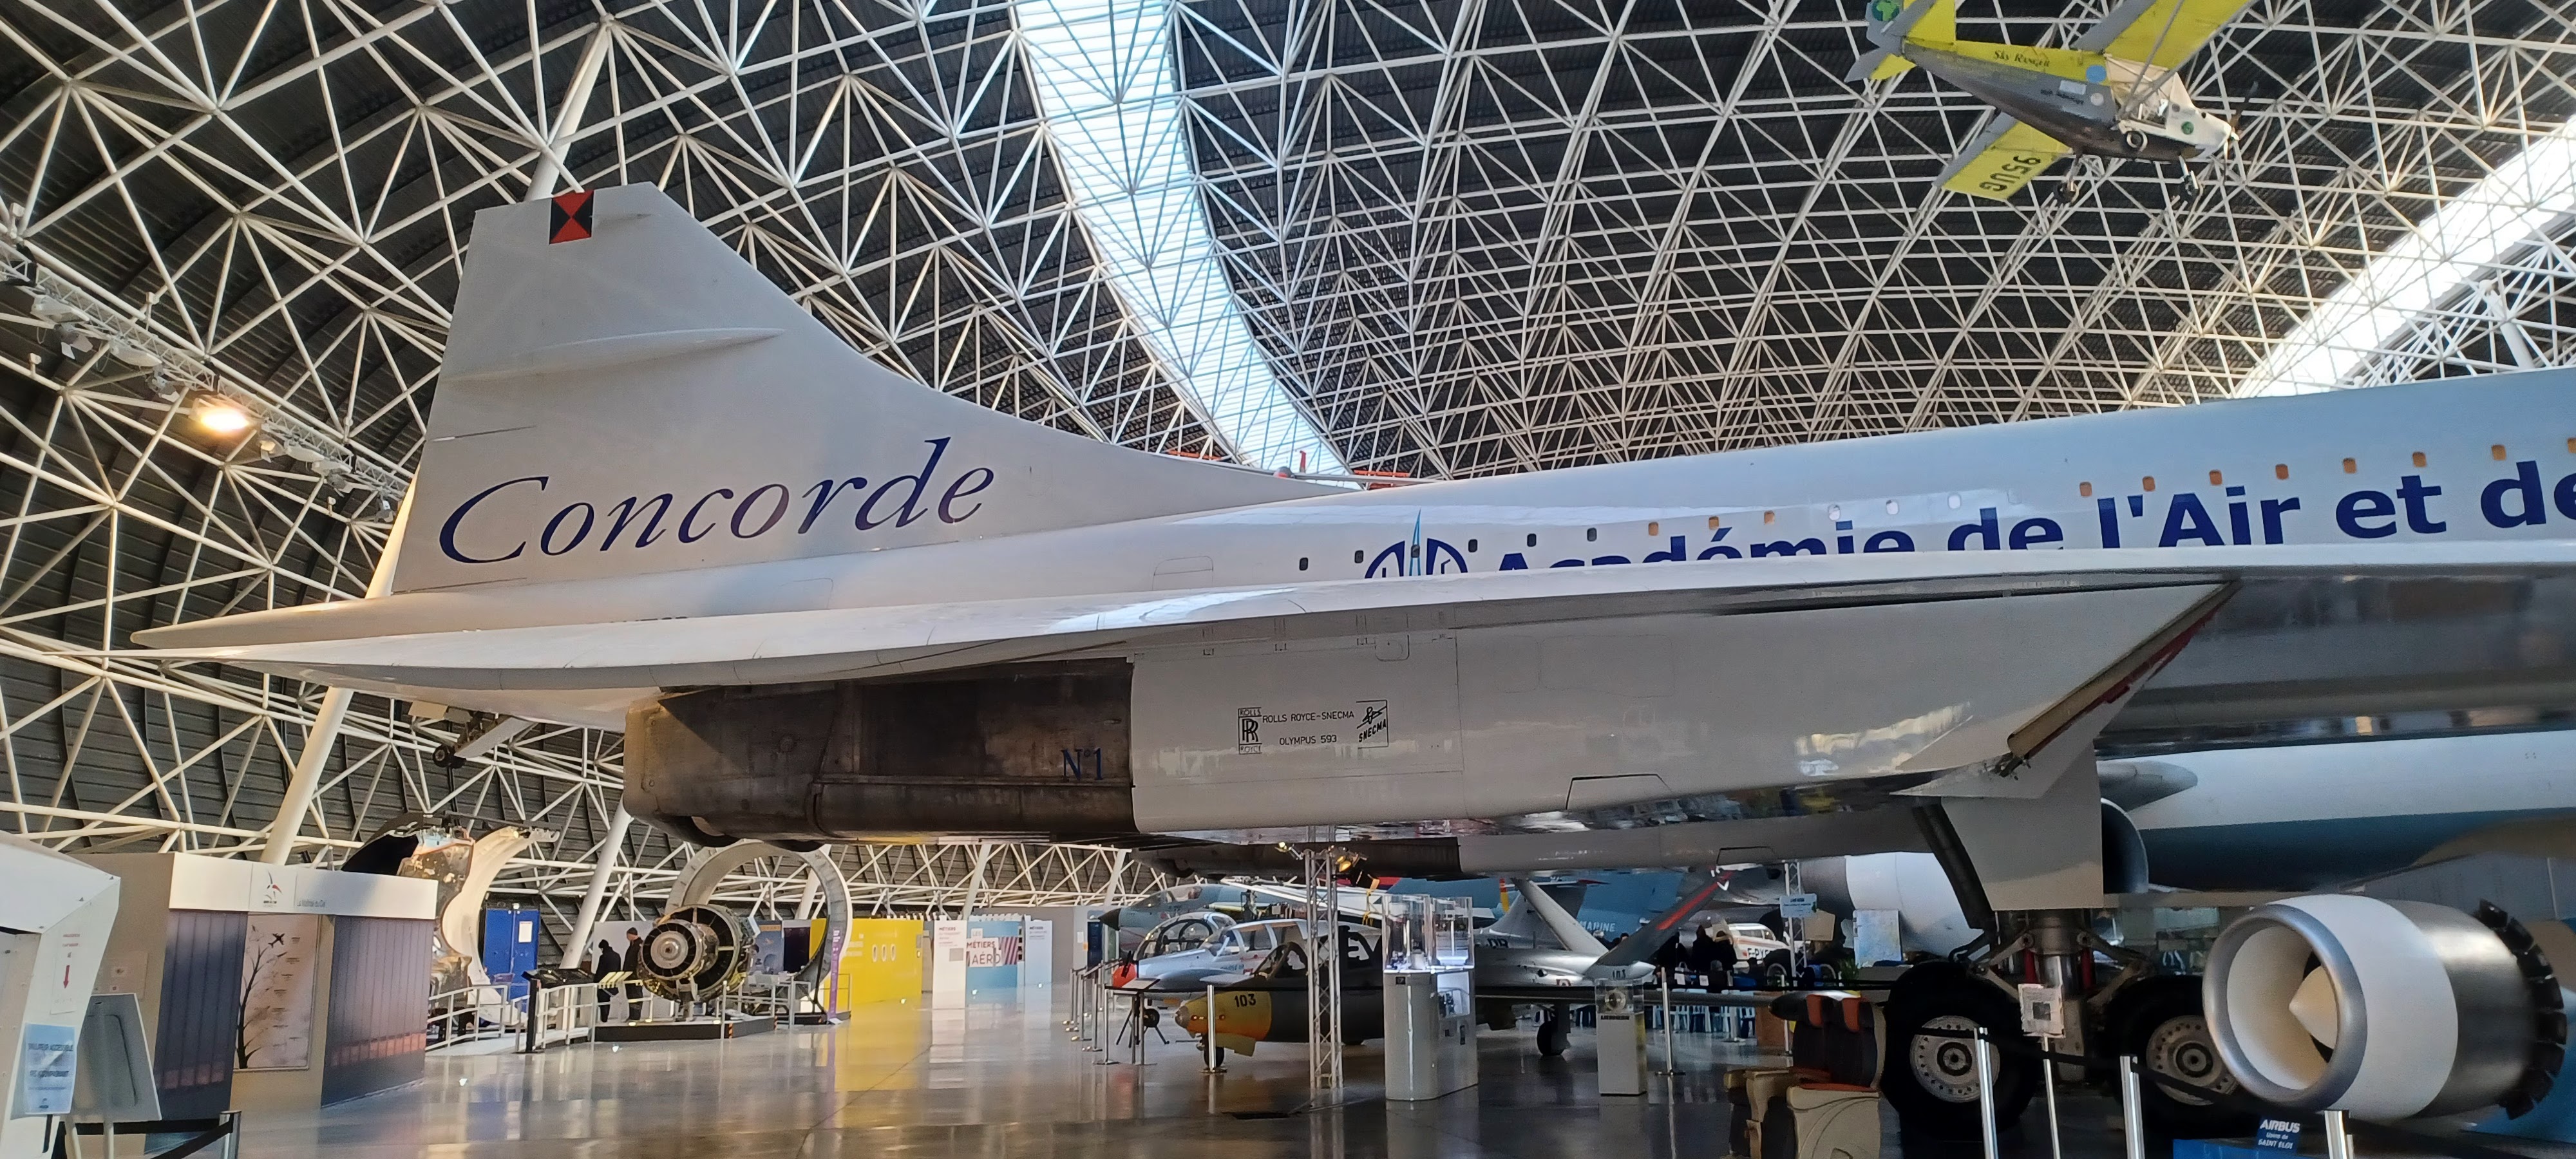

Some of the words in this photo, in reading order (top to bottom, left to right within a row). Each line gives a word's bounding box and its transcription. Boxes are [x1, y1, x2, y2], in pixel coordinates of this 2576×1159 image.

[439, 435, 995, 564] Concorde
[1947, 506, 2064, 551] de
[2097, 485, 2301, 549] l'Air
[2335, 475, 2447, 539] et
[1262, 715, 1287, 724] ROLLS
[1358, 719, 1388, 743] SNECMA
[1279, 737, 1317, 746] OLYMPUS
[1320, 735, 1338, 744] 593
[966, 940, 996, 949] MÉTIERS
[1235, 993, 1256, 1008] 103
[2259, 1119, 2300, 1133] AIRBUS
[2258, 1138, 2278, 1147] SAINT
